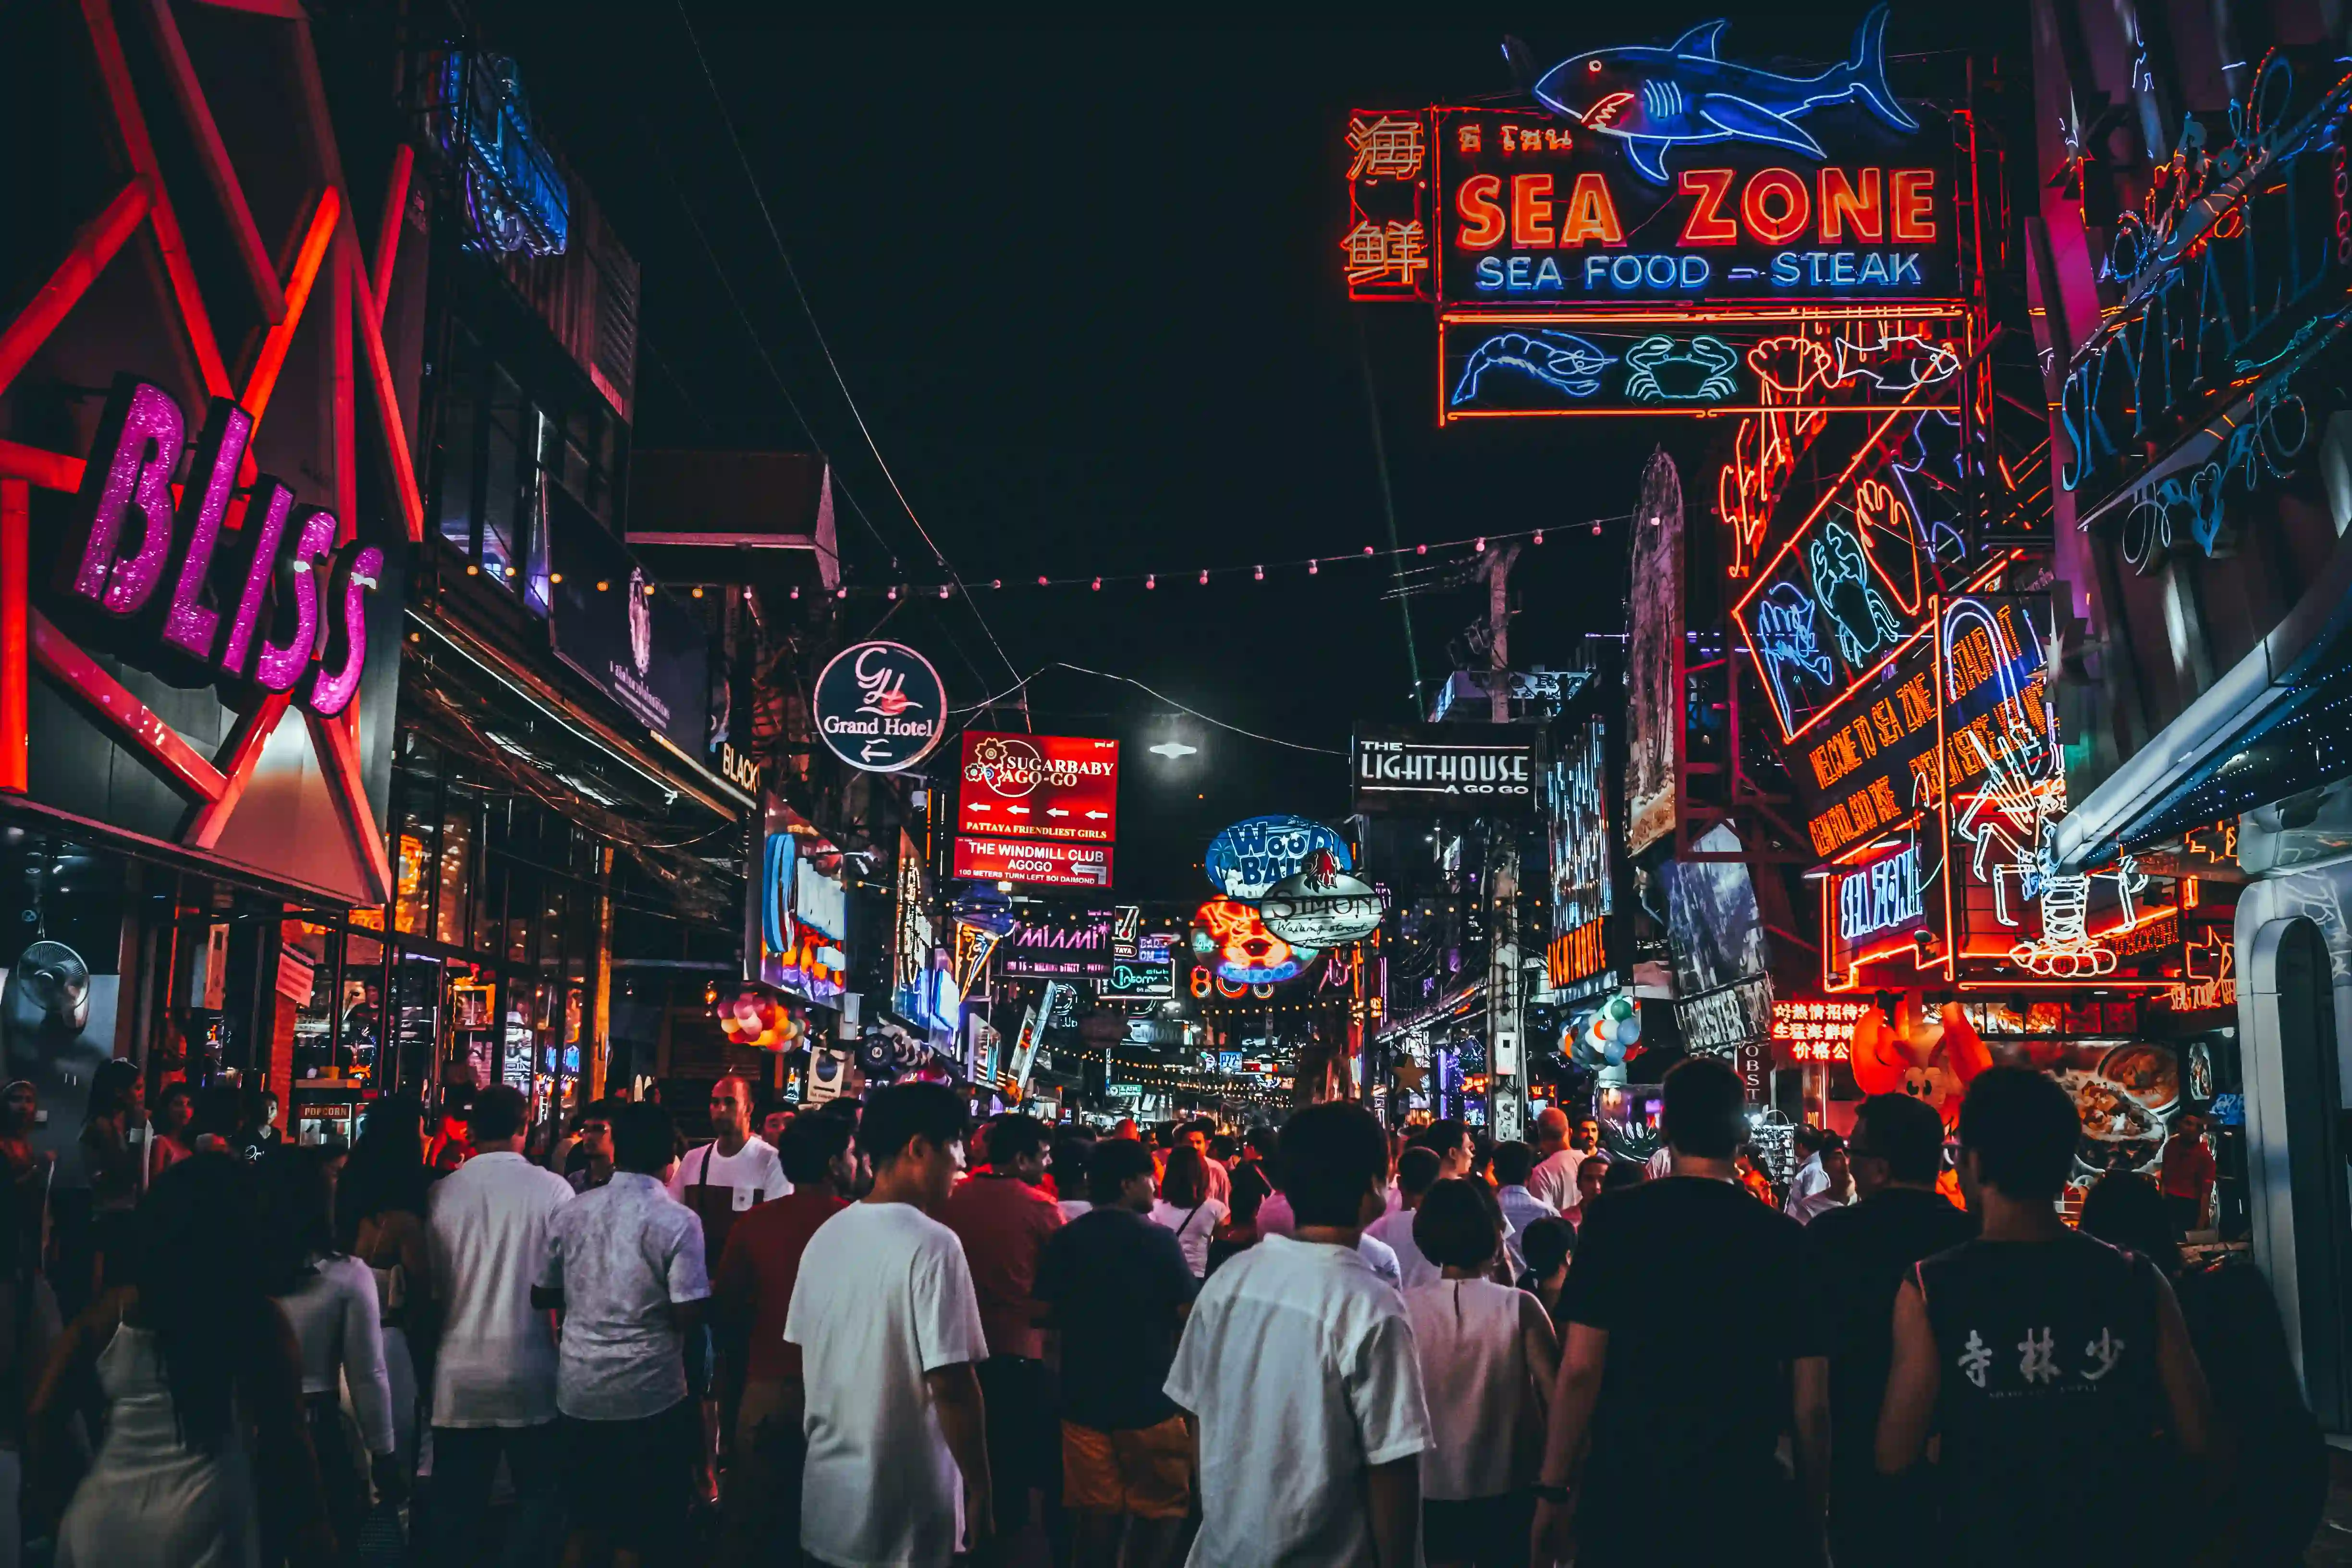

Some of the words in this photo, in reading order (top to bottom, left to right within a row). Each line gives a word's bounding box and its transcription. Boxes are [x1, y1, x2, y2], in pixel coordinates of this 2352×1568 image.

[1455, 171, 1628, 249] SEA
[1676, 167, 1938, 247] ZONE
[1474, 255, 1564, 292] SEA
[1584, 254, 1711, 290] FOOD
[1770, 252, 1923, 287] STEAK
[74, 383, 384, 715] BLISS
[824, 716, 879, 735] Grand
[884, 718, 933, 737] Hotel
[1809, 725, 1863, 790] WELCOME
[1852, 715, 1877, 759] TO
[1871, 697, 1905, 747] SEA
[1896, 672, 1939, 734] ZONE
[1360, 741, 1403, 751] THE
[723, 742, 757, 796] BLACK
[1006, 756, 1115, 776] SUGARBABY
[1361, 753, 1529, 782] LIGHTHOUSE
[1002, 770, 1078, 787] AGO-GO
[1443, 784, 1460, 794] A
[1463, 784, 1494, 794] GO
[1497, 785, 1529, 794] GO
[966, 821, 1011, 833] PATTAYA
[1013, 825, 1076, 837] FRIENDLIEST
[1077, 829, 1107, 839] GIRLS
[968, 841, 995, 855] THE
[998, 844, 1065, 860] WINDMILL
[1067, 849, 1104, 862] CLUB
[1007, 859, 1053, 872] AGOGO
[973, 870, 1003, 878] METERS
[1060, 876, 1095, 884] DAIMOND
[1272, 889, 1374, 920] SIMON
[304, 1107, 347, 1117] POPCORN
